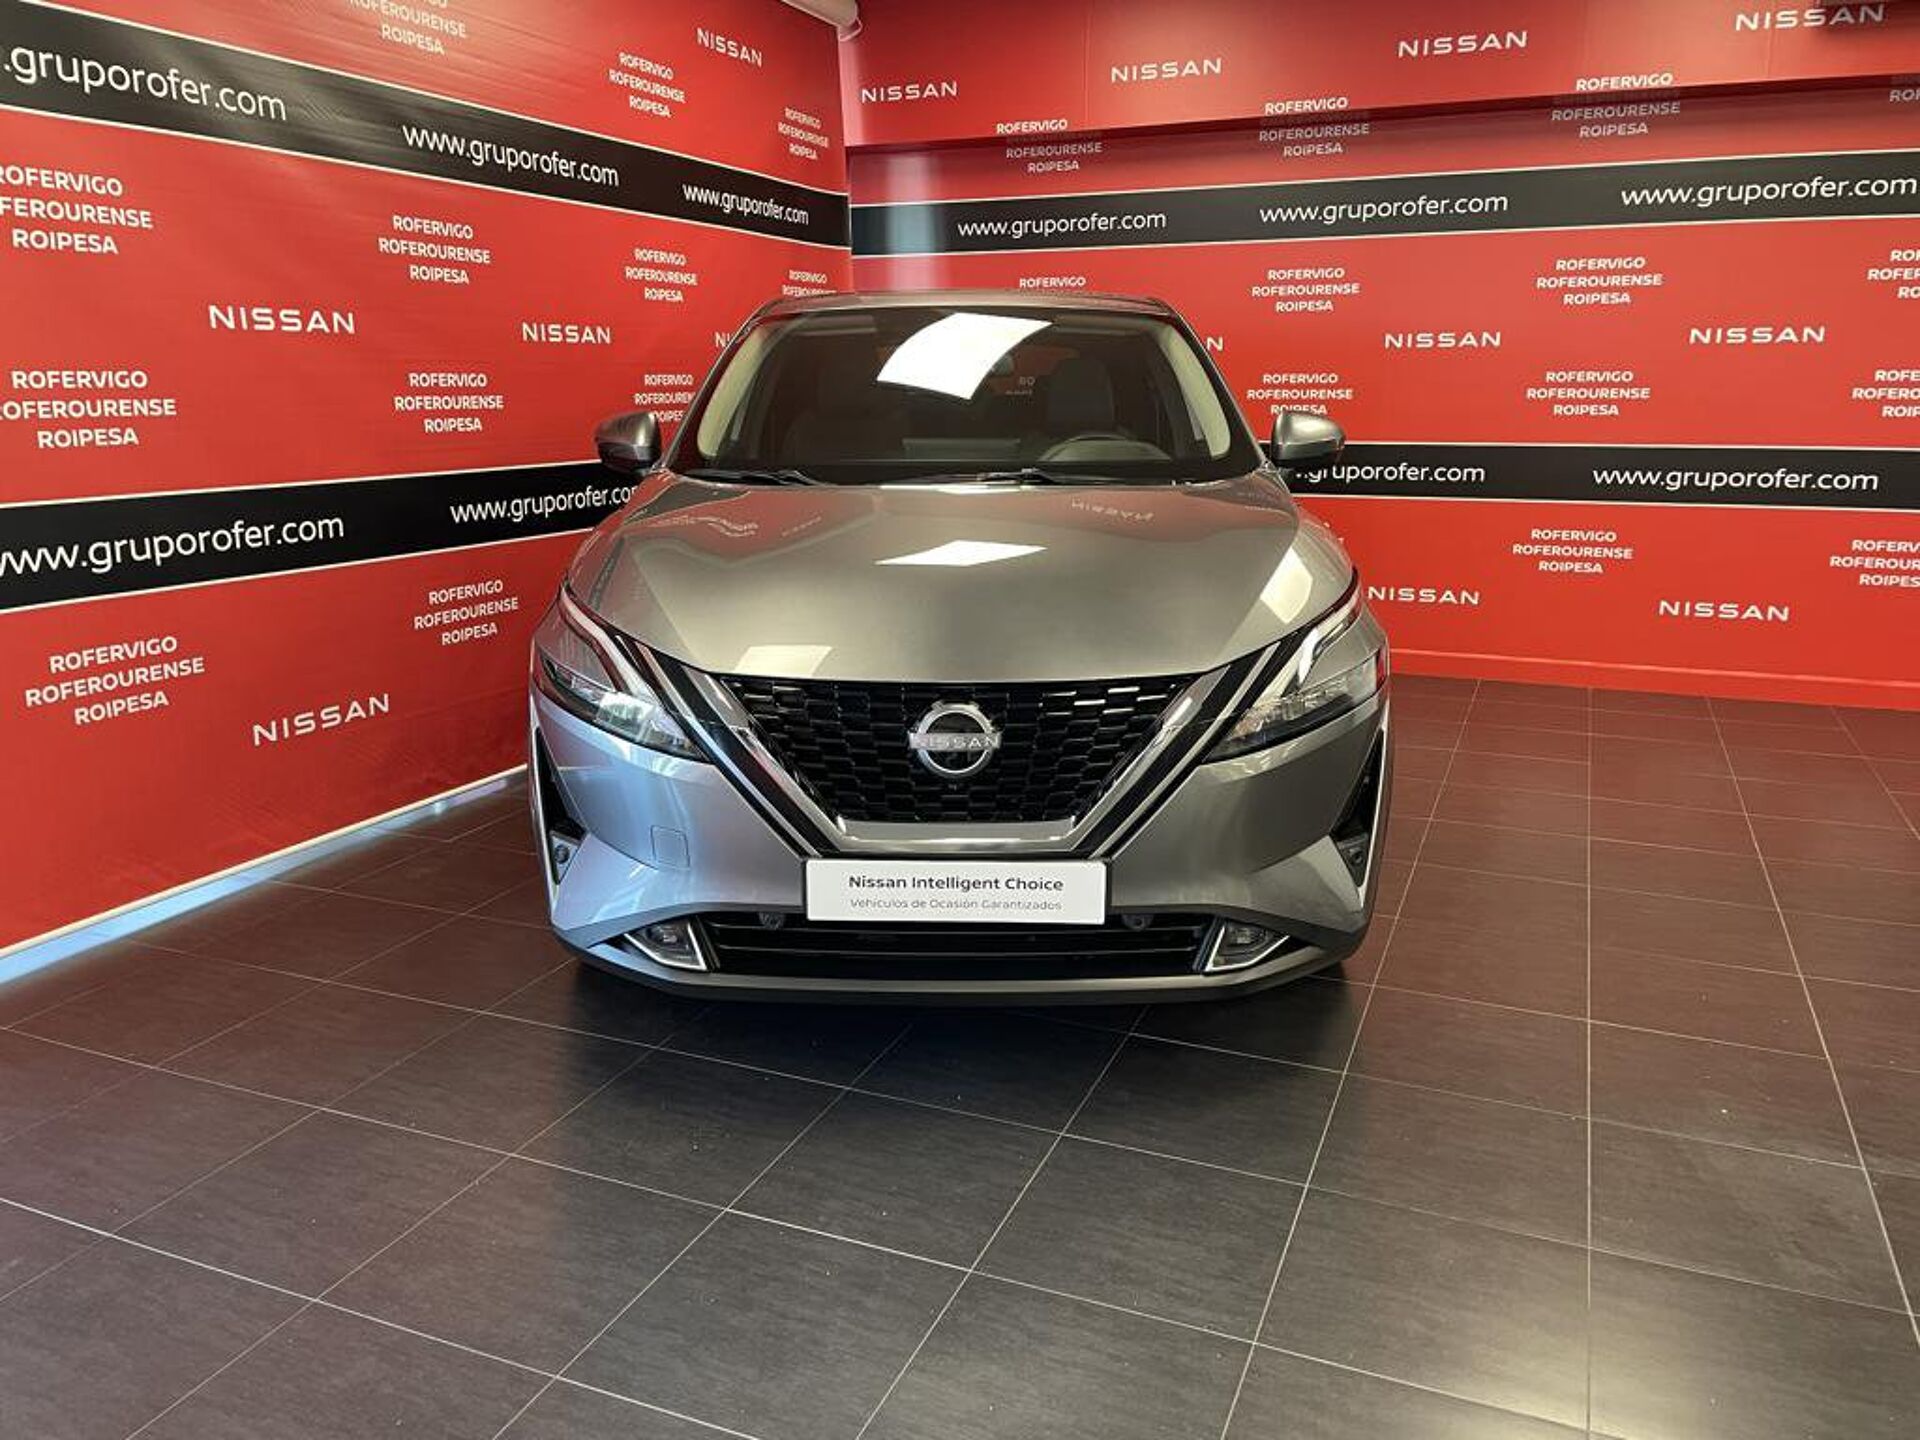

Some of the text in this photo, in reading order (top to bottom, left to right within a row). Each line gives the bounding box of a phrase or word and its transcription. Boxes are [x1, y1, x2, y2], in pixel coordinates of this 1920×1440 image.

[1735, 4, 1884, 31] NISSAN
[381, 24, 445, 55] ROIPESA
[697, 28, 762, 67] NISSAN
[1398, 31, 1528, 58] NISSAN
[619, 52, 673, 80] ROFERVIGO
[1111, 58, 1222, 82] NISSAN
[609, 69, 686, 103] ROFEROURENSE
[1576, 72, 1673, 91] ROFERVIGO
[862, 81, 957, 104] NISSAN
[629, 95, 671, 118] ROIPESA
[1264, 97, 1349, 115] ROFERVIGO
[1552, 102, 1680, 121] ROFEROURENSE
[996, 119, 1068, 134] ROFERVIGO
[1259, 123, 1370, 141] ROFEROURENSE
[1579, 122, 1648, 138] ROIPESA
[403, 124, 619, 187] www.gruporofer.com
[1006, 142, 1102, 158] ROFEROURENSE
[1283, 142, 1343, 157] ROIPESA
[1027, 161, 1080, 173] ROIPESA
[1621, 175, 1917, 207] www.gruporofer.com
[683, 183, 808, 225] www.gruporofer.com
[1260, 193, 1508, 225] www.gruporofer.com
[393, 215, 473, 239] ROFERVIGO
[958, 212, 1166, 239] www.gruporofer.com
[12, 228, 118, 254] ROIPESA
[379, 238, 490, 264] ROFEROURENSE
[635, 248, 686, 266] ROFERVIGO
[1268, 267, 1345, 280] ROFERVIGO
[1556, 257, 1645, 271] ROFERVIGO
[409, 265, 469, 284] ROIPESA
[626, 266, 697, 286] ROFEROURENSE
[1019, 276, 1087, 289] ROFERVIGO
[1536, 273, 1663, 289] ROFEROURENSE
[644, 287, 683, 302] ROIPESA
[1252, 283, 1360, 297] ROFEROURENSE
[1563, 292, 1631, 306] ROIPESA
[1275, 301, 1334, 313] ROIPESA
[210, 305, 355, 334] NISSAN
[522, 323, 610, 344] NISSAN
[1385, 331, 1501, 348] NISSAN
[1689, 327, 1825, 344] NISSAN
[12, 371, 148, 389] ROFERVIGO
[409, 373, 487, 388] ROFERVIGO
[644, 374, 694, 387] ROFERVIGO
[1263, 373, 1338, 384] ROFERVIGO
[1546, 370, 1633, 384] ROFERVIGO
[395, 395, 504, 411] ROFEROURENSE
[1247, 389, 1353, 400] ROFEROURENSE
[1526, 387, 1650, 400] ROFEROURENSE
[0, 398, 177, 420] OFEROURENSE
[1553, 404, 1619, 416] ROIPESA
[424, 418, 482, 433] ROIPESA
[37, 427, 139, 449] ROIPESA
[1593, 468, 1879, 491] www.gruporofer.com
[1531, 529, 1617, 543] ROFERVIGO
[0, 516, 344, 577] ww.gruporofer.com
[1512, 544, 1633, 560] ROFEROURENSE
[1539, 560, 1603, 573] ROIPESA
[429, 580, 503, 606] ROFERVIGO
[1368, 586, 1480, 605] NISSAN
[414, 597, 518, 630] ROFEROURENSE
[1659, 600, 1789, 622] NISSAN
[441, 623, 498, 646] ROIPESA
[50, 637, 177, 674] ROFERVIGO
[25, 657, 205, 707] ROFEROURENSE
[74, 691, 169, 725] ROIPESA
[253, 694, 390, 746] NISSAN
[849, 875, 1064, 892] Nissan Intelligent Choice
[912, 899, 927, 909] de
